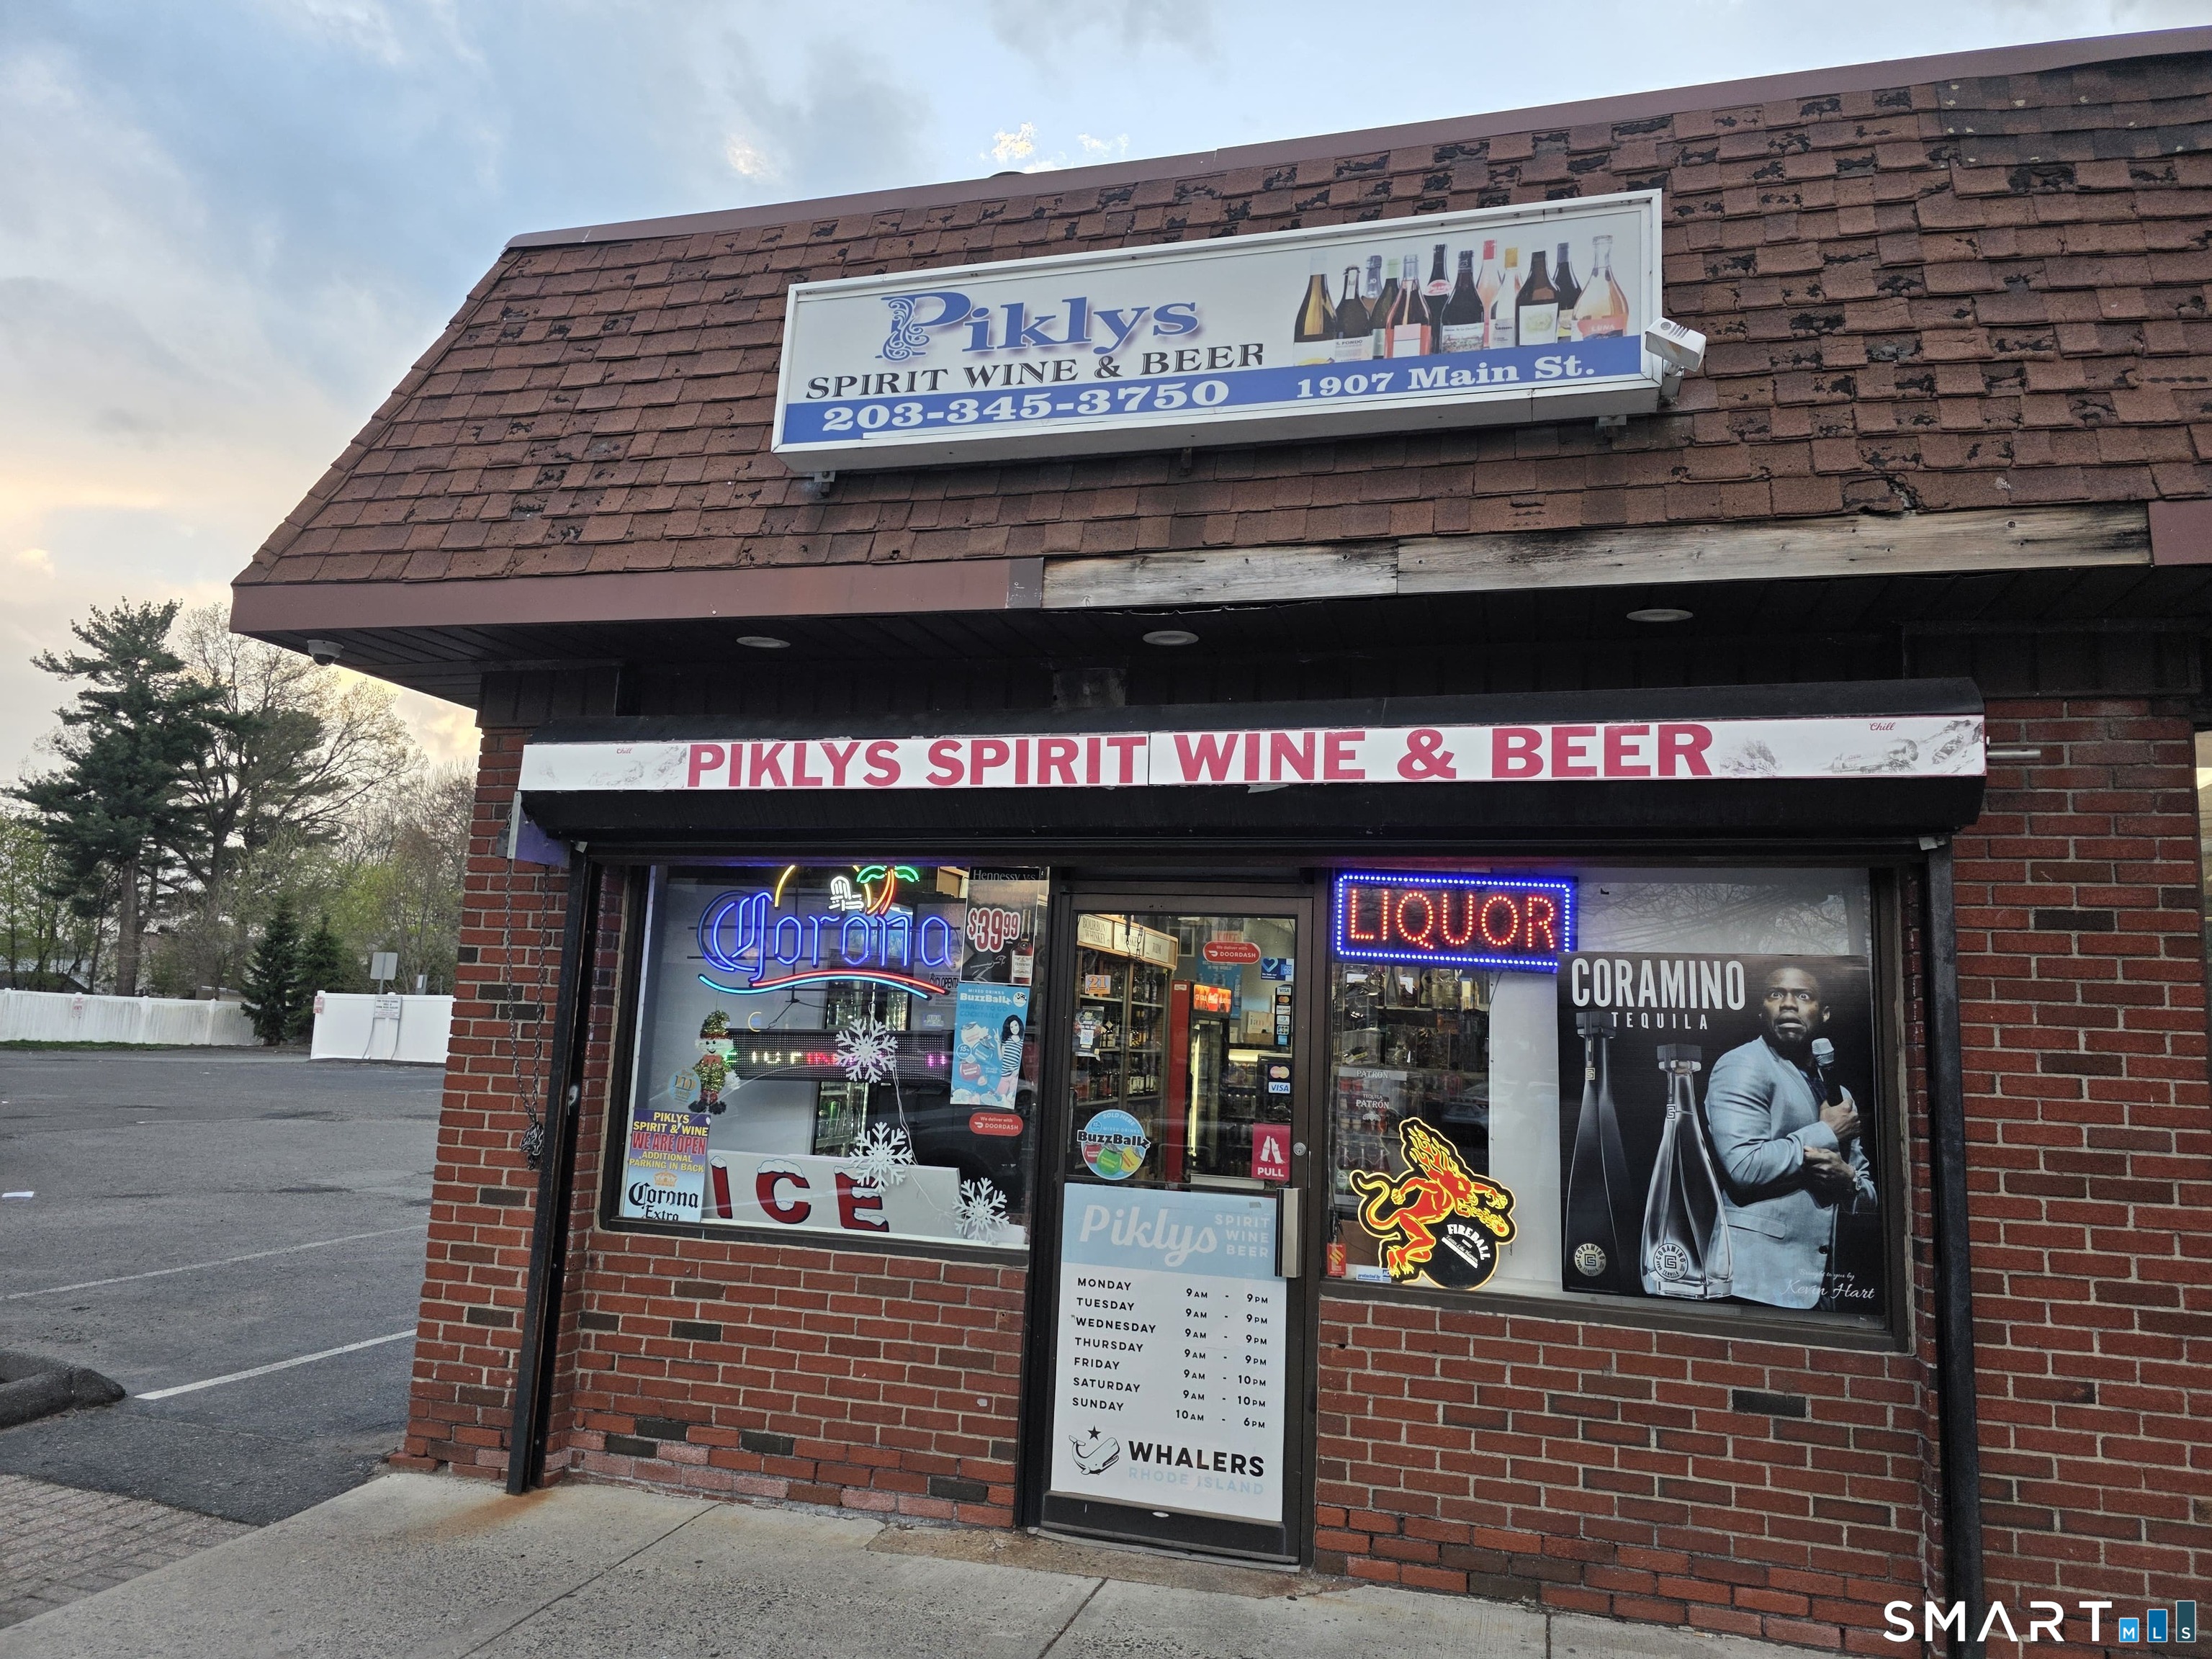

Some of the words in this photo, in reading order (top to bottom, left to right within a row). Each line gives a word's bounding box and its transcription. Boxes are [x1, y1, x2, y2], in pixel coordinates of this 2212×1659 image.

[875, 291, 1200, 360] Piklys
[806, 369, 948, 400] SPIRIT
[963, 359, 1078, 388] WINE
[1094, 356, 1120, 378] &
[1140, 343, 1264, 376] BEER
[1297, 372, 1394, 398] 1907
[1408, 362, 1519, 390] Main
[1535, 355, 1595, 379] St.
[822, 379, 1229, 432] 203-345-3750
[1870, 722, 1896, 731] Chill
[687, 740, 902, 788] PIKLYS
[926, 737, 1147, 786] SPIRIT
[1173, 731, 1365, 783] WINE
[1396, 728, 1456, 781] &
[1491, 724, 1712, 778] BEER
[974, 870, 1020, 881] Hennessy
[1350, 889, 1555, 950] LIQUOR
[698, 891, 953, 981] Corona
[1085, 929, 1105, 944] WHISKEY
[1089, 976, 1107, 988] 21
[1571, 958, 1746, 1010] CORAMINO
[960, 993, 1012, 1005] BuzzBallz
[1611, 1011, 1708, 1030] TEQUILA
[654, 1112, 690, 1124] PIKLYS
[1120, 1115, 1136, 1127] HERE
[634, 1121, 667, 1133] SPIRIT
[670, 1125, 678, 1134] &
[682, 1126, 709, 1136] WINE
[632, 1131, 651, 1150] WE
[652, 1133, 675, 1152] ARE
[677, 1136, 707, 1155] OPEN
[1077, 1130, 1151, 1150] BuzzBallz
[642, 1151, 693, 1163] ADDITIONAL
[629, 1159, 667, 1169] PARKING
[680, 1164, 704, 1172] BACK
[1257, 1166, 1285, 1177] PULL
[629, 1182, 698, 1208] Corona
[710, 1155, 890, 1233] ICE
[642, 1205, 679, 1220] Extra
[1215, 1213, 1272, 1227] SPIRIT
[1080, 1205, 1218, 1267] Piklys
[1226, 1229, 1269, 1244] WINE
[1447, 1224, 1491, 1260] FIREBALL
[1226, 1245, 1269, 1258] BEER
[1575, 1244, 1606, 1261] CORAMINO
[1655, 1246, 1686, 1263] CORAMINO
[1078, 1278, 1131, 1290] MONDAY
[1846, 1272, 1855, 1281] by
[1779, 1279, 1828, 1295] Kevin
[1830, 1282, 1876, 1299] Hart
[1076, 1298, 1134, 1310] TUESDAY
[1076, 1318, 1156, 1333] WEDNESDAY
[1075, 1337, 1143, 1352] THURSDAY
[1074, 1357, 1119, 1370] FRIDAY
[1074, 1377, 1140, 1392] SATURDAY
[1073, 1398, 1123, 1411] SUNDAY
[1128, 1440, 1264, 1478] WHALERS
[1129, 1466, 1189, 1485] RHODE
[1197, 1474, 1264, 1495] ISLAND
